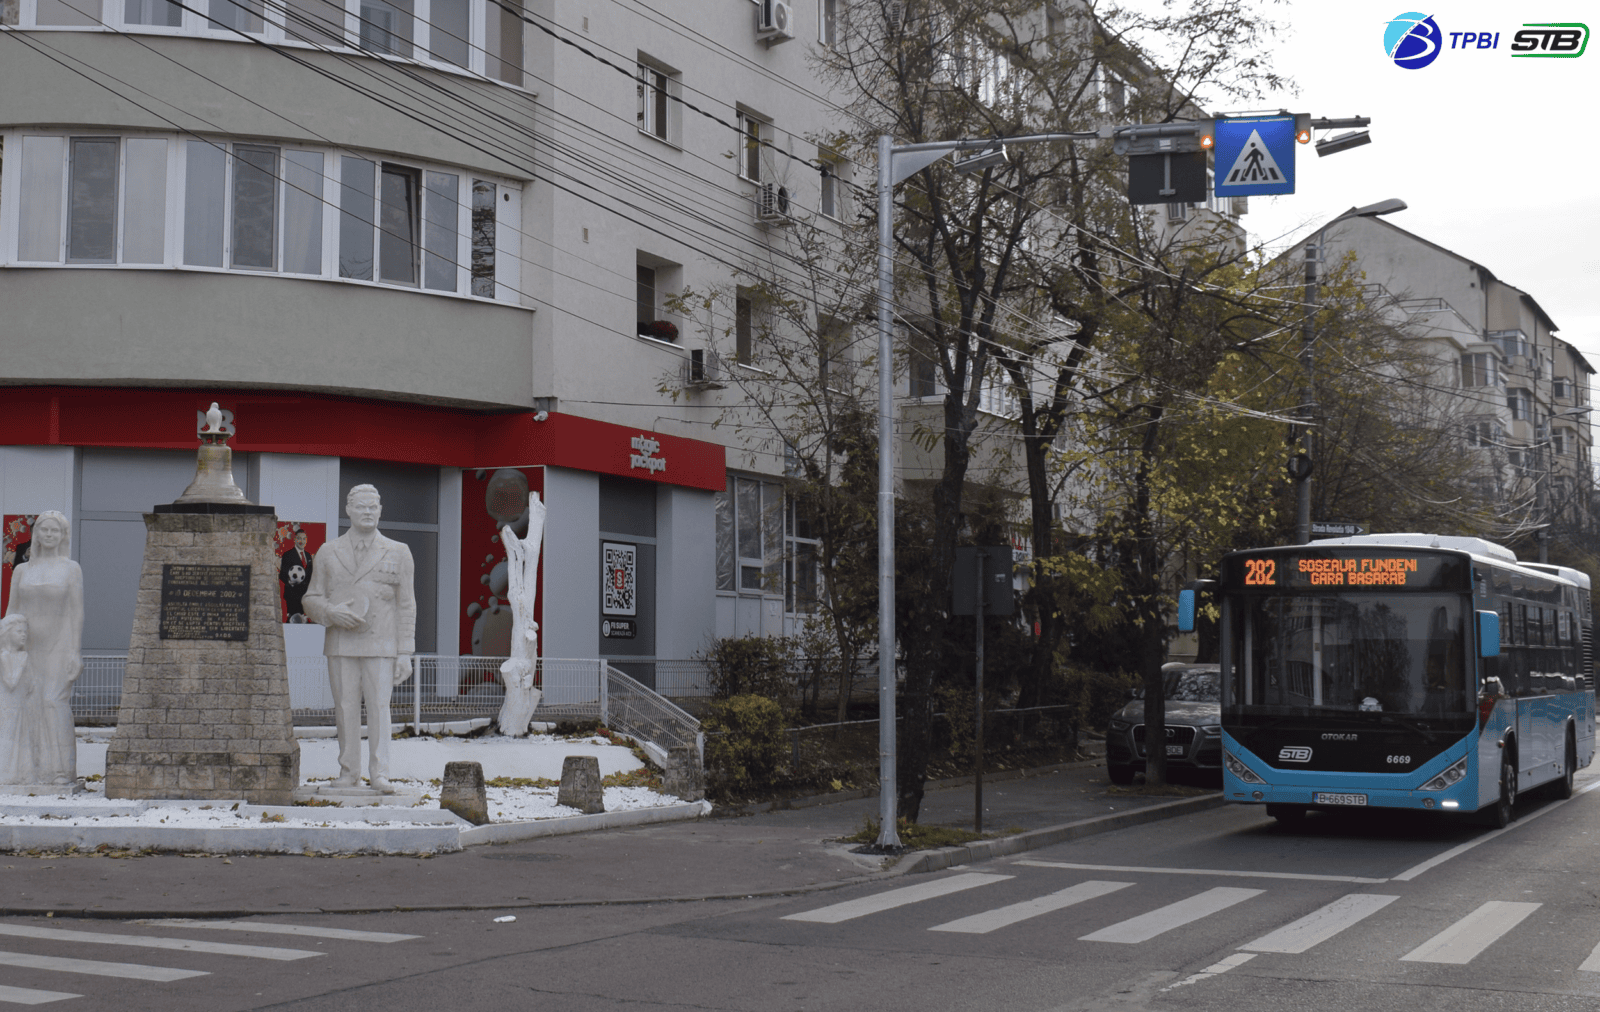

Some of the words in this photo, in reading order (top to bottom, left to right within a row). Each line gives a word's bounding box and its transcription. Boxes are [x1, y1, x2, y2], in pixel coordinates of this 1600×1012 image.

[630, 454, 666, 475] jackpot
[1245, 559, 1276, 585] 282
[1360, 558, 1418, 572] FUNDENI
[1310, 572, 1344, 585] GARA
[1348, 572, 1406, 585] BASARAB
[1321, 733, 1358, 742] OTOKAR
[1278, 748, 1310, 760] STB
[1386, 755, 1411, 764] 6669
